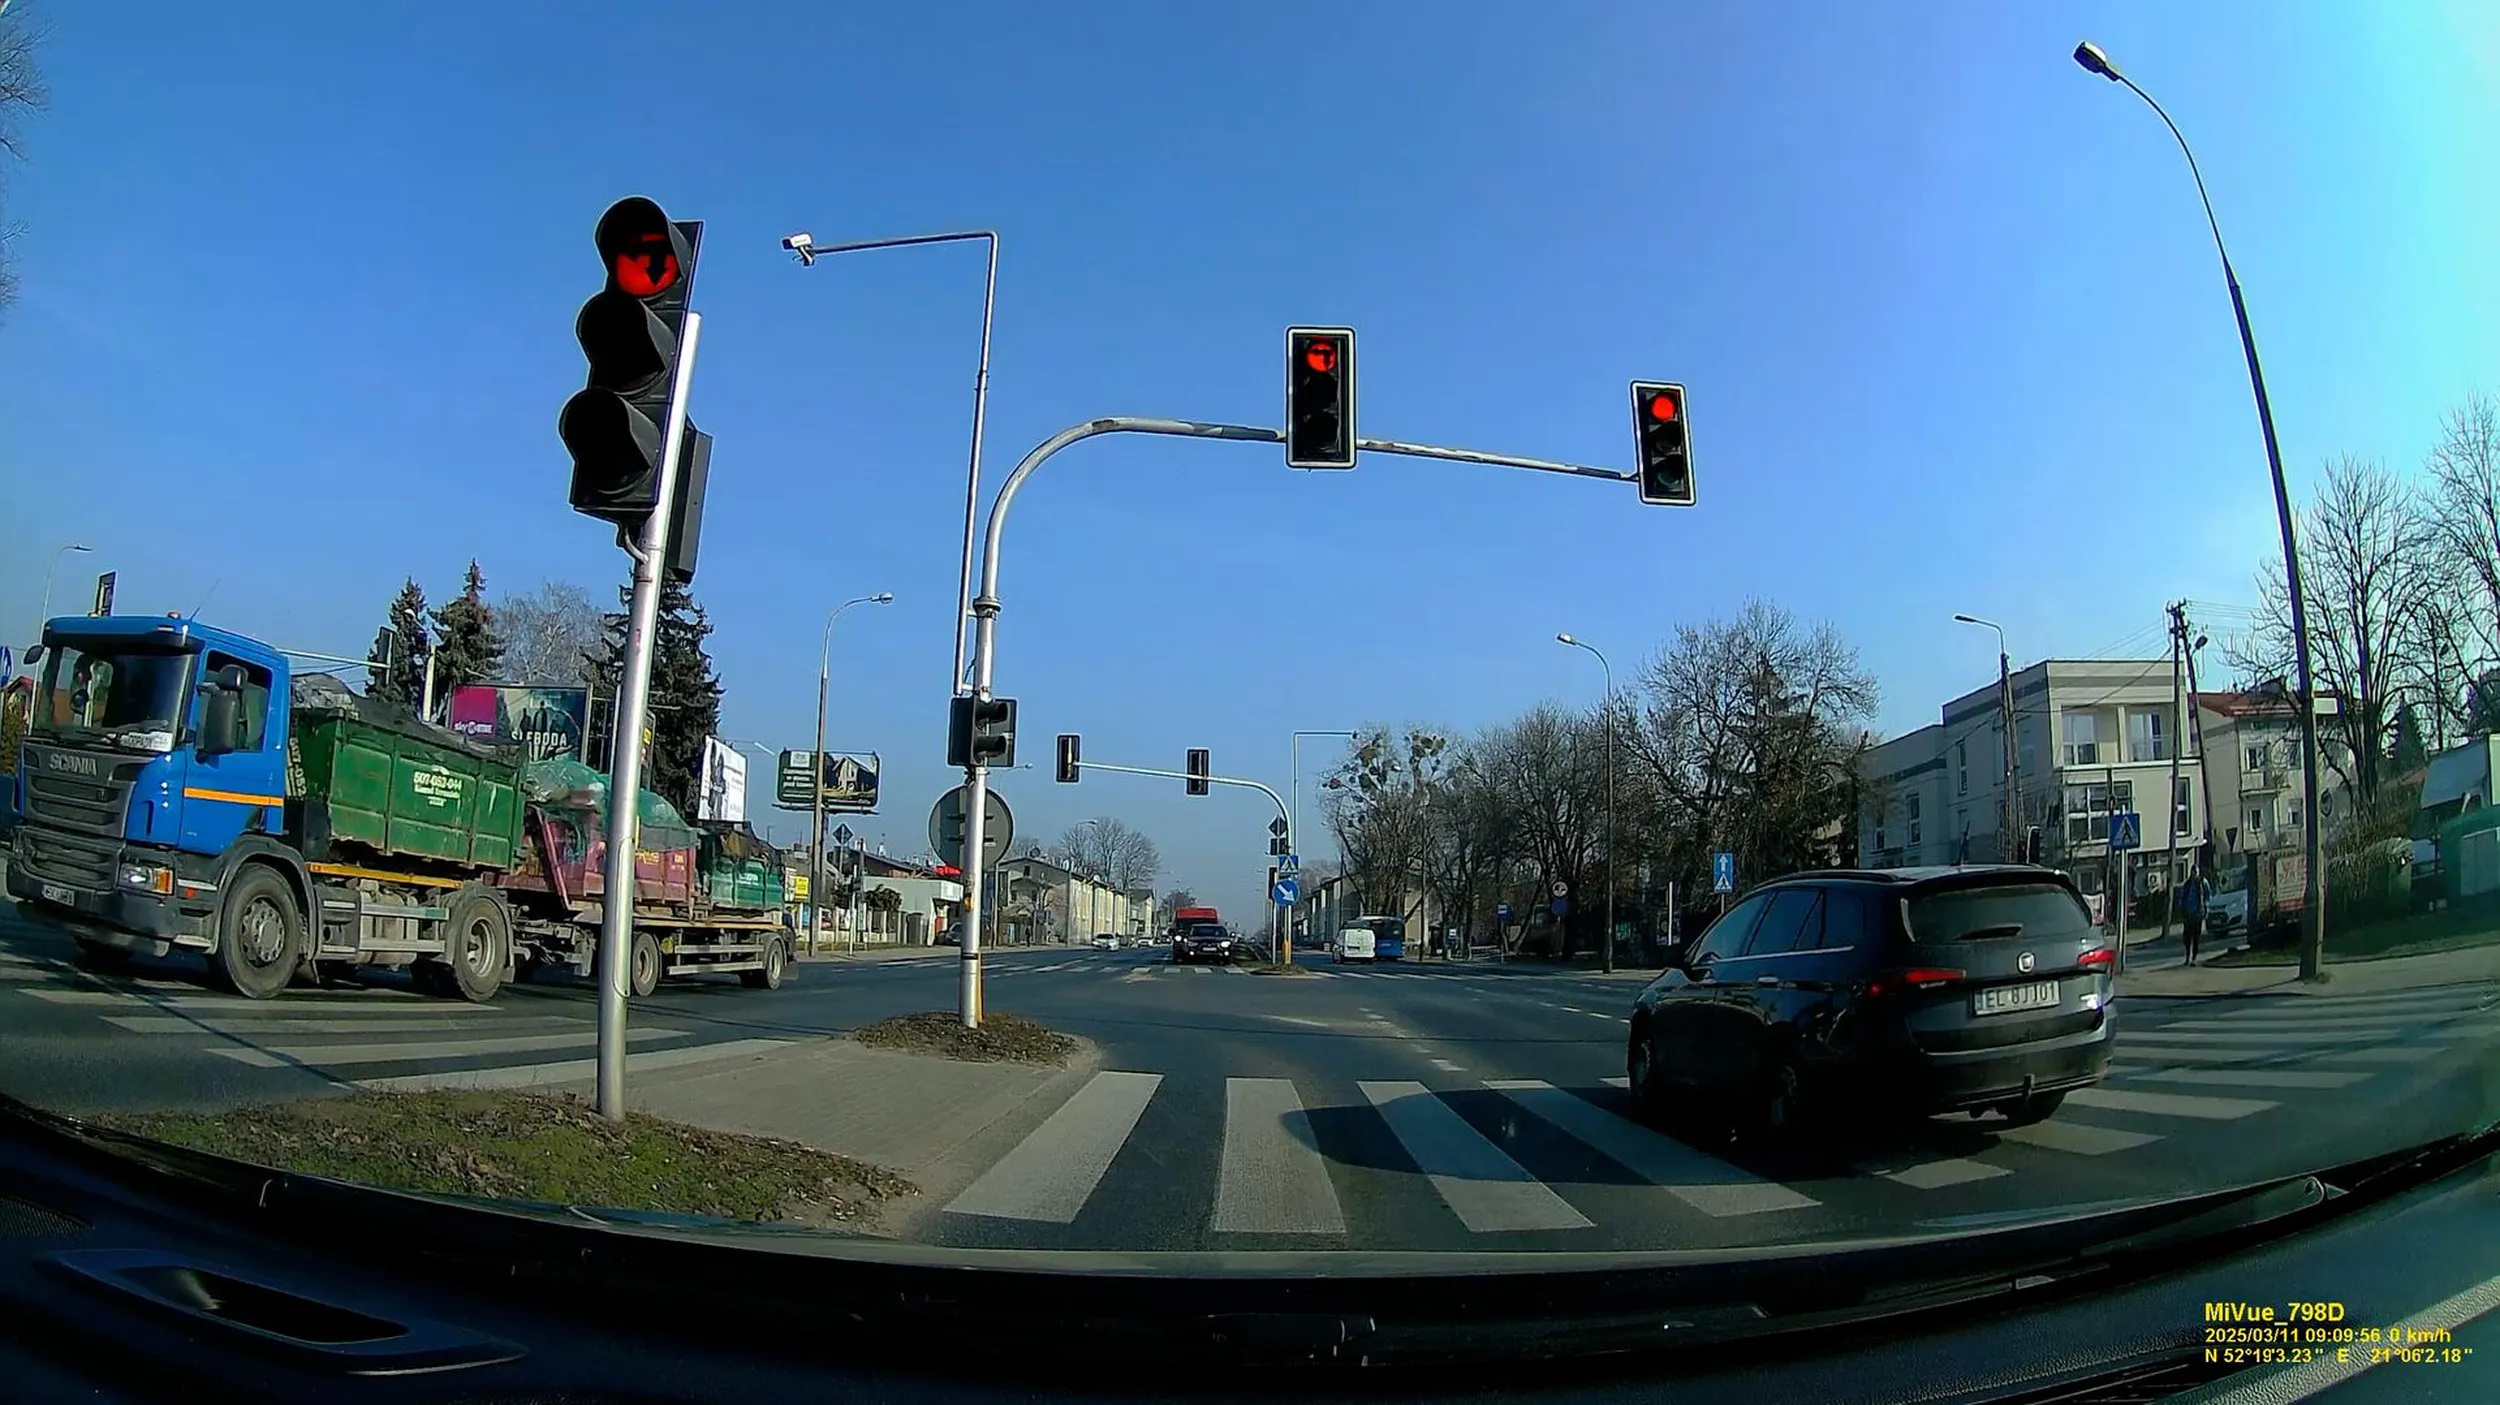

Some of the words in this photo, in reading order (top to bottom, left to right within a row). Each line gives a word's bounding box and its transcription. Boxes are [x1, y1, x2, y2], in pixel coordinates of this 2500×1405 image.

[49, 753, 98, 776] SCANIA
[1985, 988, 2005, 1008] EL
[2011, 982, 2055, 1004] 8JJ01
